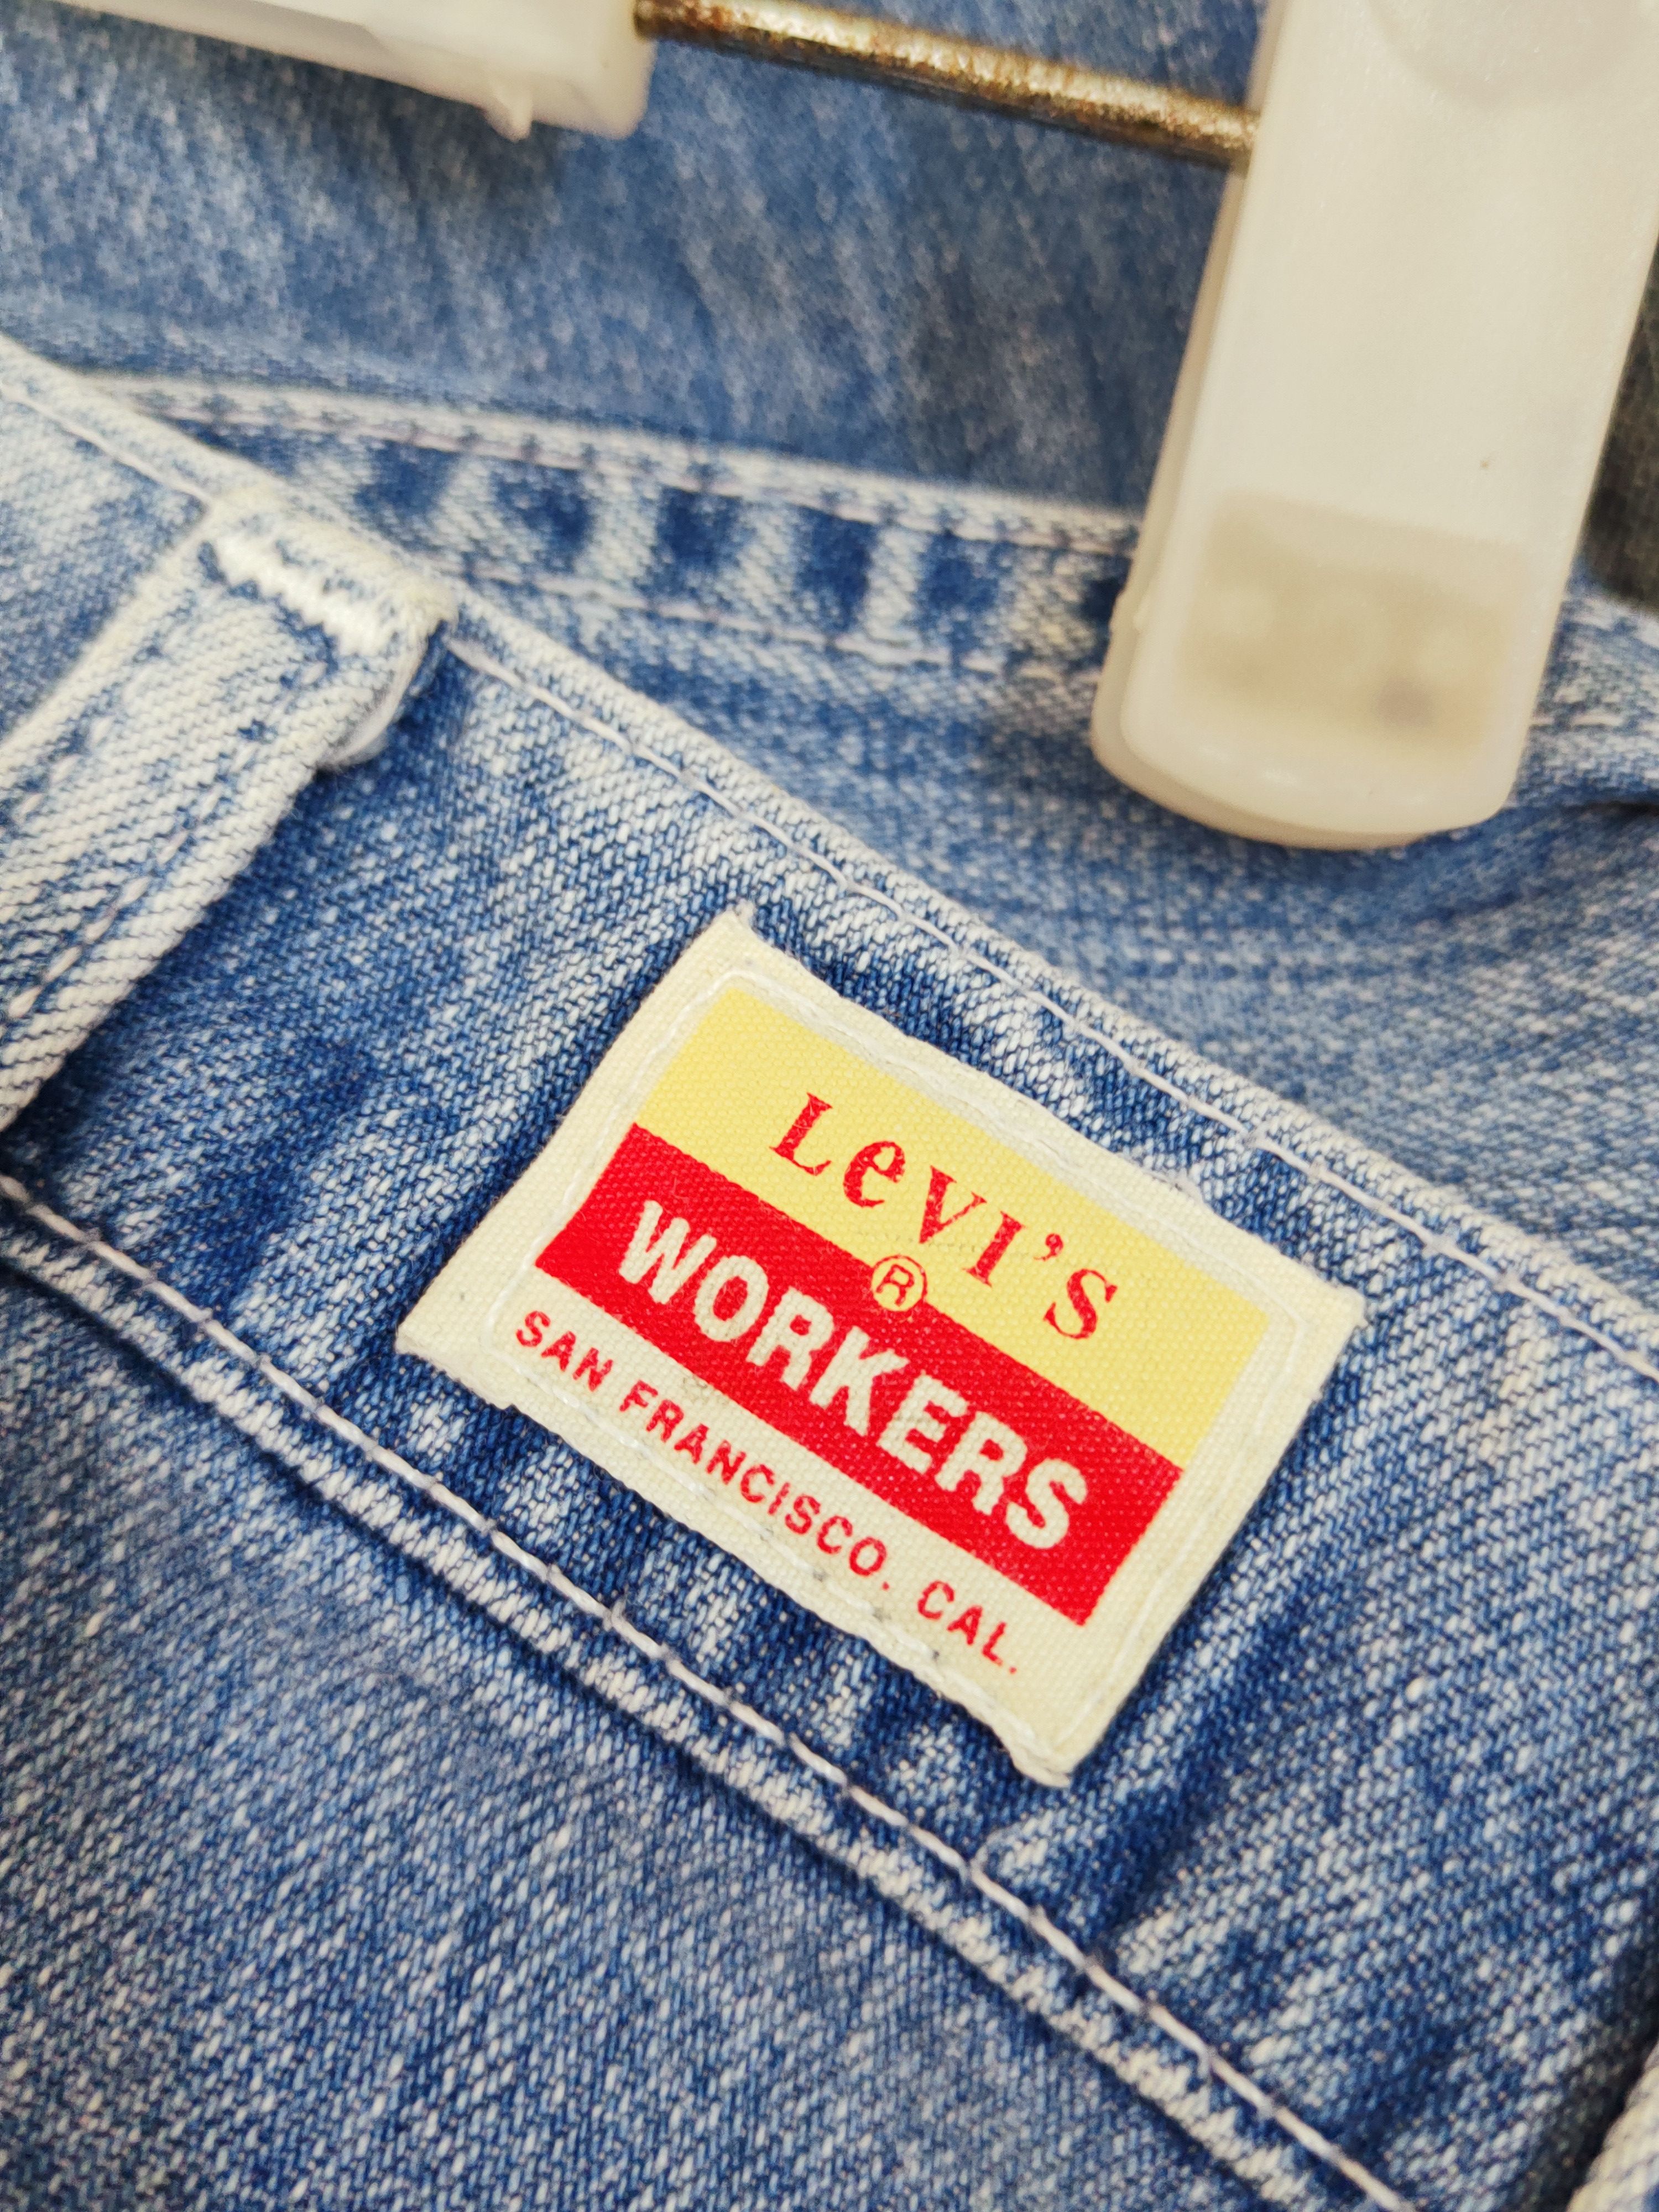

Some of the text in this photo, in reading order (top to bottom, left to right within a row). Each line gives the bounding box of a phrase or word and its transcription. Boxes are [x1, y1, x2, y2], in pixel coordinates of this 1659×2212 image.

[618, 1200, 1088, 1550] WORKERS
[870, 1254, 928, 1312] ®
[515, 1310, 614, 1392] SAN
[917, 1580, 1018, 1674] CAL.
